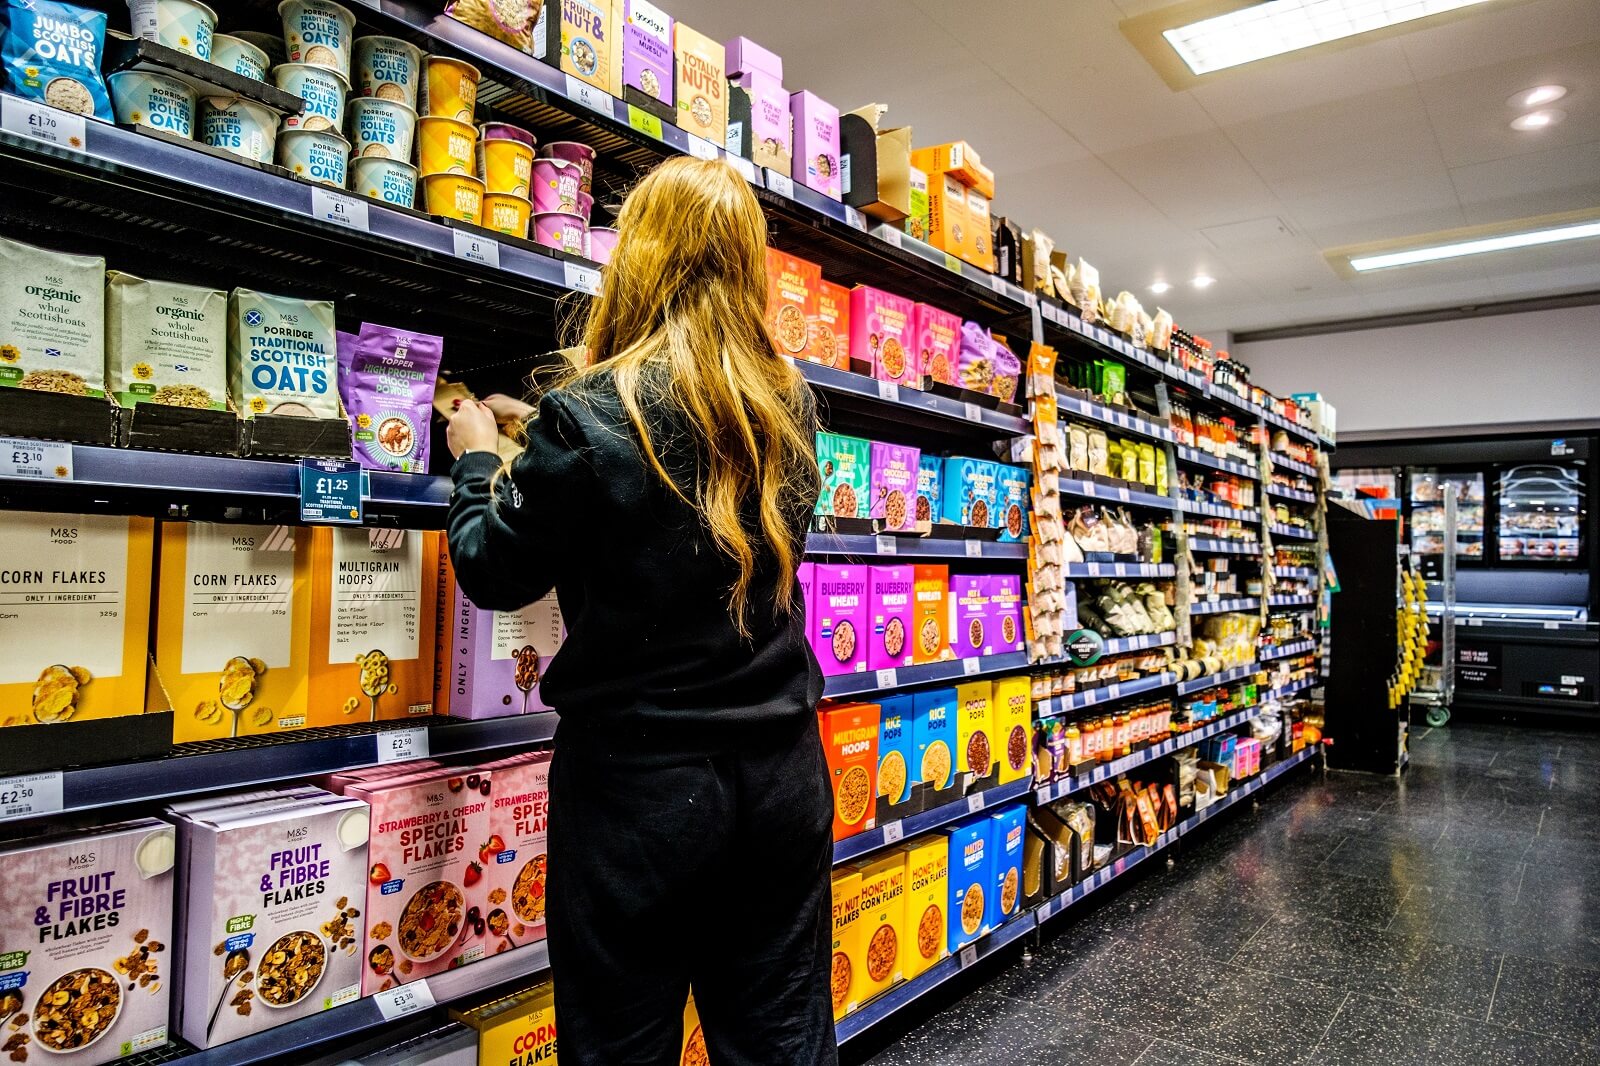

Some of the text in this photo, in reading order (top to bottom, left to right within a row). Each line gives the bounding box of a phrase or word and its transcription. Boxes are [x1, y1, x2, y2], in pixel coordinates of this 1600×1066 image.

[304, 8, 336, 20] PORRIDGE
[564, 0, 591, 20] FRUIT
[33, 16, 94, 42] JUMBO
[301, 15, 339, 28] TRADITIONAL
[301, 22, 339, 36] ROLLED
[564, 8, 604, 42] NUT &
[33, 28, 96, 53] SCOTTISH
[303, 32, 339, 48] OATS
[631, 28, 643, 38] FRUIT
[34, 39, 96, 71] OATS
[639, 40, 662, 58] MUESLI
[682, 51, 720, 80] TOTALLY
[682, 64, 720, 99] NUTS
[148, 94, 190, 112] TRADITIONAL
[152, 88, 188, 104] PORRIDGE
[148, 102, 189, 122] ROLLED
[28, 114, 56, 128] £1.70
[150, 113, 189, 135] OATS
[334, 203, 344, 214] £1
[472, 242, 480, 252] £1
[45, 275, 63, 285] M&S
[25, 284, 81, 304] organic
[172, 296, 188, 305] M&S
[38, 302, 70, 315] whole
[156, 305, 205, 322] organic
[19, 308, 86, 328] Scottish oats
[168, 320, 195, 332] whole
[280, 314, 299, 323] M&S
[151, 327, 209, 344] Scottish oats
[264, 326, 313, 340] PORRIDGE
[250, 337, 325, 354] TRADITIONAL
[250, 349, 326, 368] SCOTTISH
[381, 357, 414, 368] TOPPER
[252, 364, 328, 394] OATS
[364, 364, 425, 381] HIGH PROTEIN
[378, 375, 410, 388] CHOCO
[376, 383, 413, 397] POWDER
[12, 452, 42, 464] £3.10
[316, 478, 348, 494] £1.25
[50, 528, 78, 538] M&S
[233, 537, 254, 546] M&S
[339, 562, 399, 573] MULTIGRAIN
[1, 571, 106, 584] CORN FLAKES
[194, 575, 277, 586] CORN FLAKES
[339, 574, 373, 584] HOOPS
[437, 553, 447, 637] INGREDIENTS
[822, 582, 864, 595] BLUEBERRY
[876, 582, 912, 594] BLUEBERRY
[461, 594, 471, 639] INGRED
[458, 663, 467, 694] ONLY
[966, 698, 986, 711] CHOCO
[1008, 695, 1025, 707] CHOCO
[929, 707, 945, 720] RICE
[969, 710, 984, 720] POPS
[1011, 706, 1024, 715] POPS
[886, 716, 901, 729] RICE
[928, 719, 946, 731] POPS
[833, 725, 877, 746] MULTIGRAIN
[884, 728, 902, 740] POPS
[393, 738, 412, 749] £2.50
[842, 740, 870, 756] HOOPS
[1, 789, 33, 804] £2.50
[427, 793, 444, 803] M&S
[494, 791, 548, 809] STRAWBERRY
[378, 802, 486, 833] STRAWBERRY & CHERRY
[288, 827, 308, 838] M&S
[400, 817, 468, 846] SPECIAL
[270, 843, 322, 870] FRUIT
[403, 836, 464, 864] FLAKES
[69, 852, 96, 866] M&S
[964, 850, 984, 867] WHEATS
[260, 860, 330, 892] & FIBRE
[48, 871, 115, 902] FRUIT
[263, 880, 325, 908] FLAKES
[861, 872, 903, 900] HONEY NUT
[845, 896, 859, 912] NUT
[861, 897, 880, 911] CORN
[882, 884, 903, 903] FLAKES
[34, 889, 126, 926] & FIBRE
[230, 921, 251, 932] FIBRE
[835, 909, 859, 929] FLAKES
[39, 912, 120, 943] FLAKES
[394, 993, 413, 1006] £3.30
[514, 1024, 556, 1054] CORN
